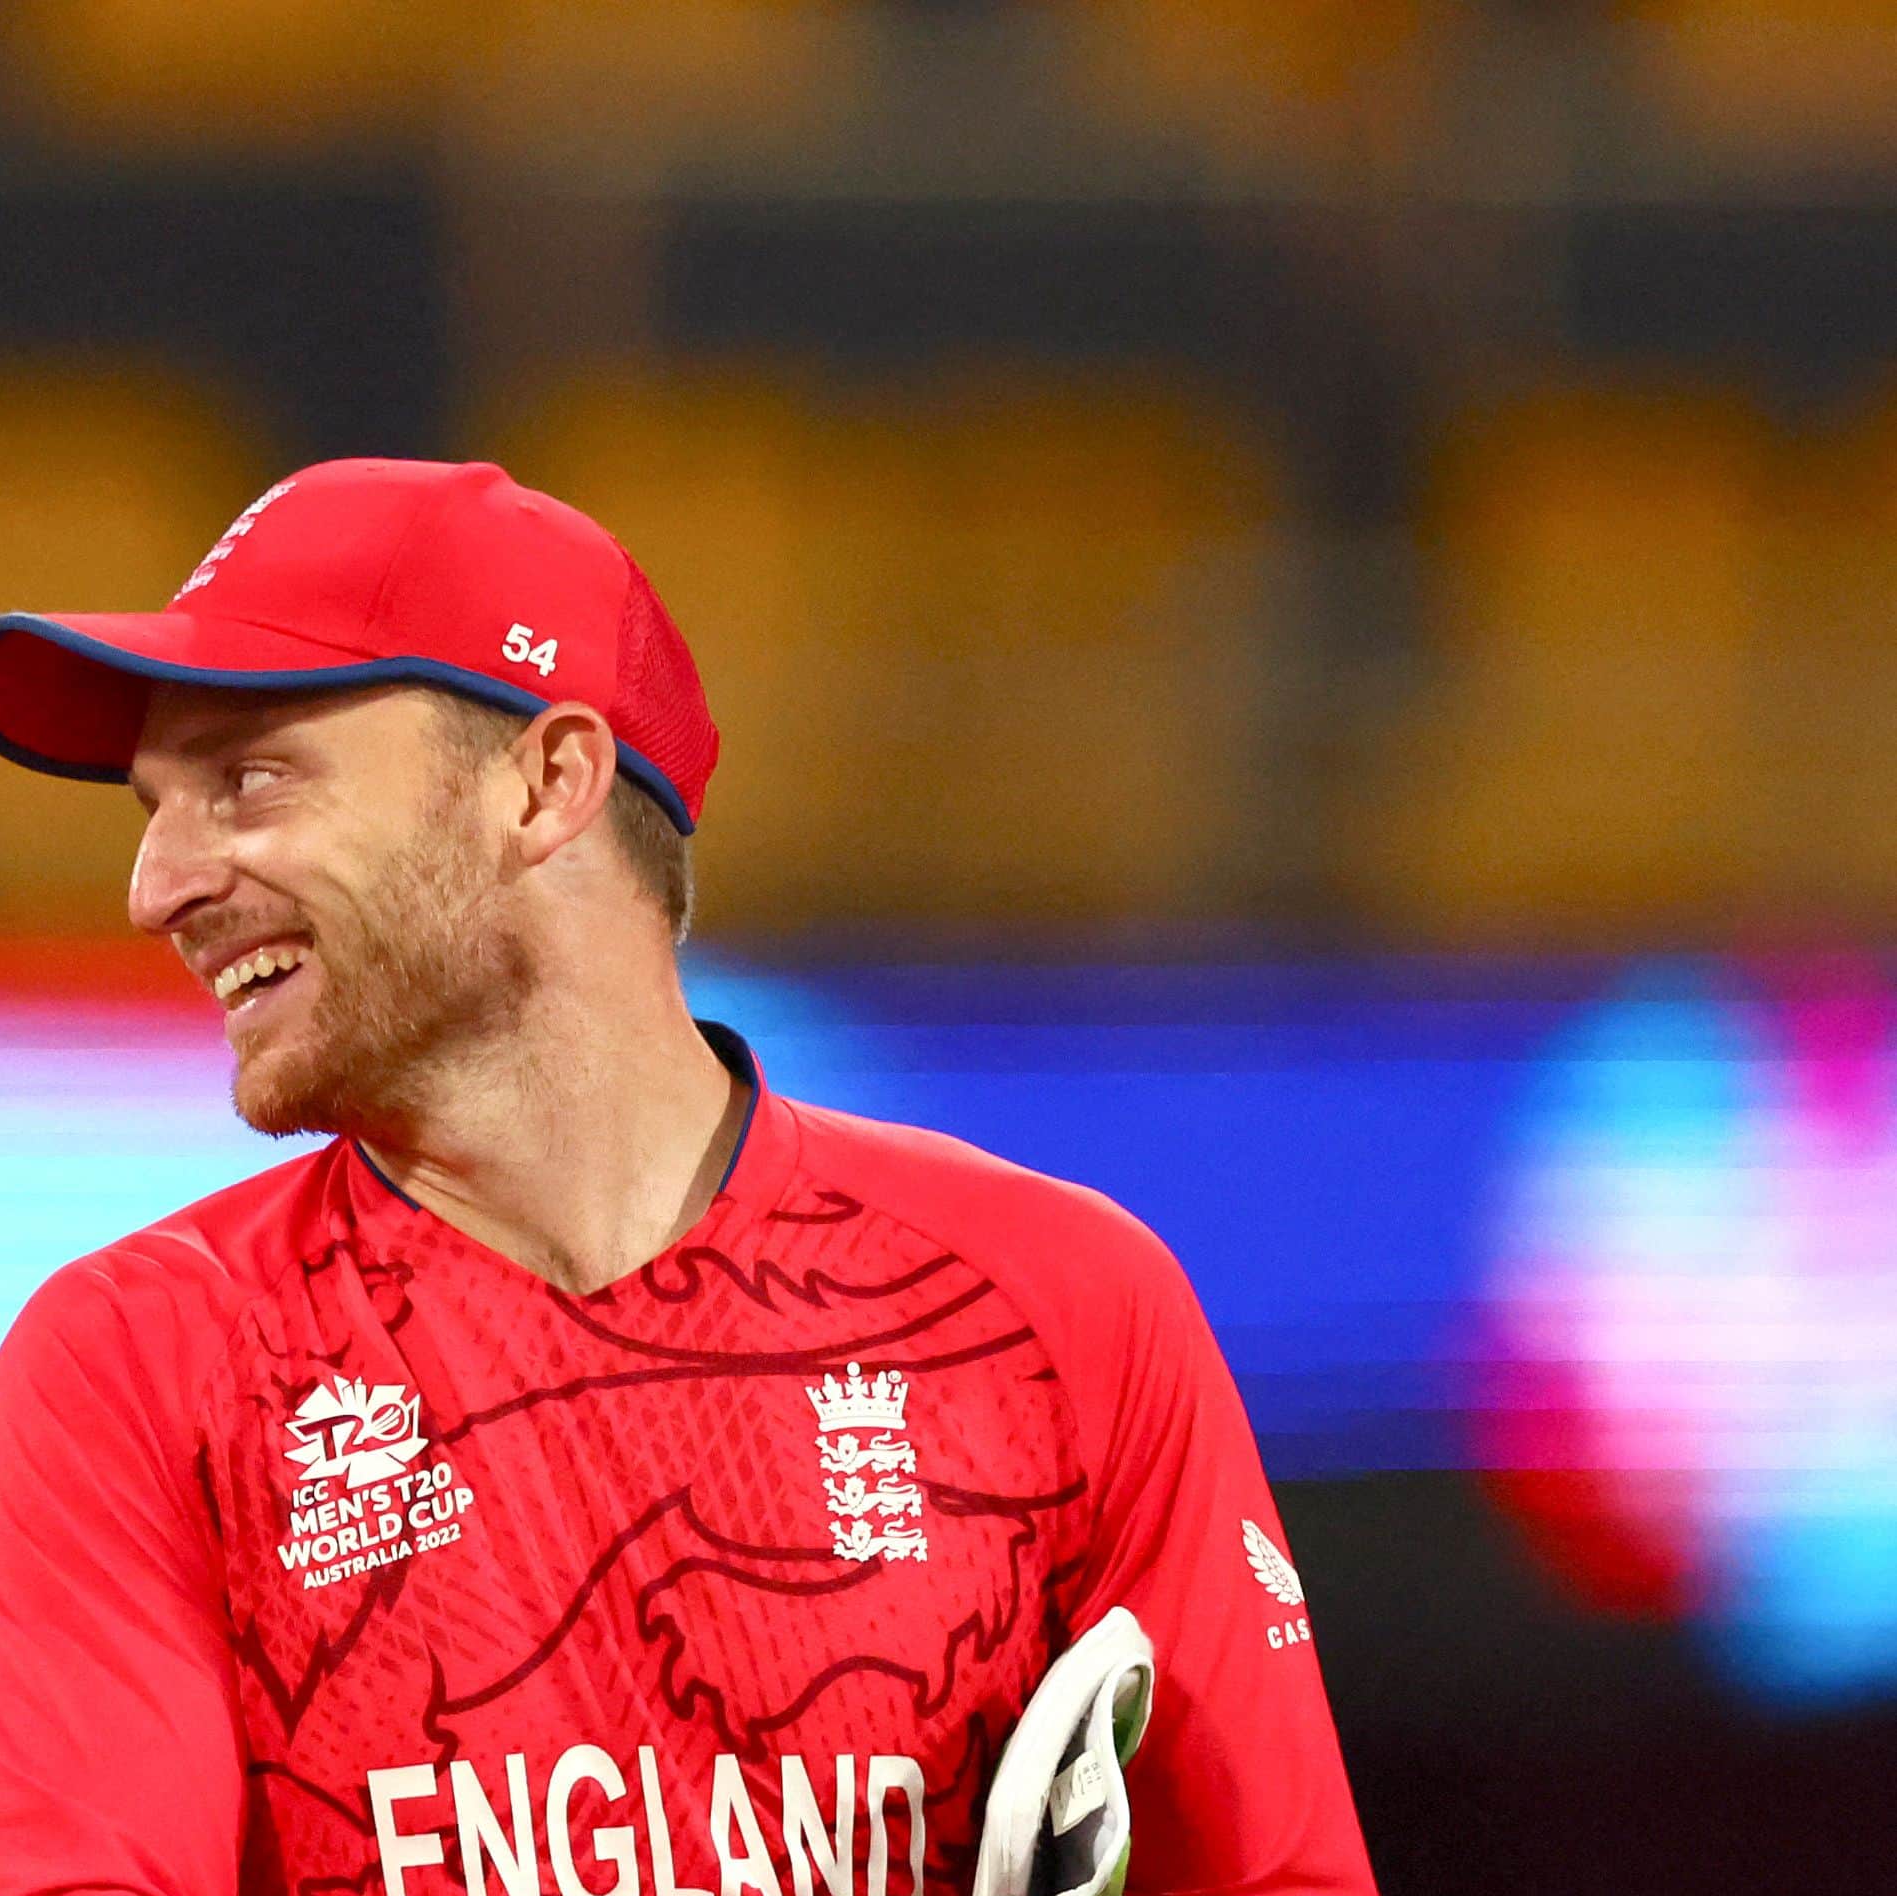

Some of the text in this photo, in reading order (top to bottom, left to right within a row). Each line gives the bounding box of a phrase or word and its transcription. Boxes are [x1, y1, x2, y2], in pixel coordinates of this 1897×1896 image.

[502, 622, 558, 677] 54
[277, 1487, 475, 1571] WORLD CUP
[290, 1461, 453, 1537] MEN'S T20
[292, 1480, 329, 1509] ICC
[303, 1522, 462, 1591] AUSTRALIA 2022
